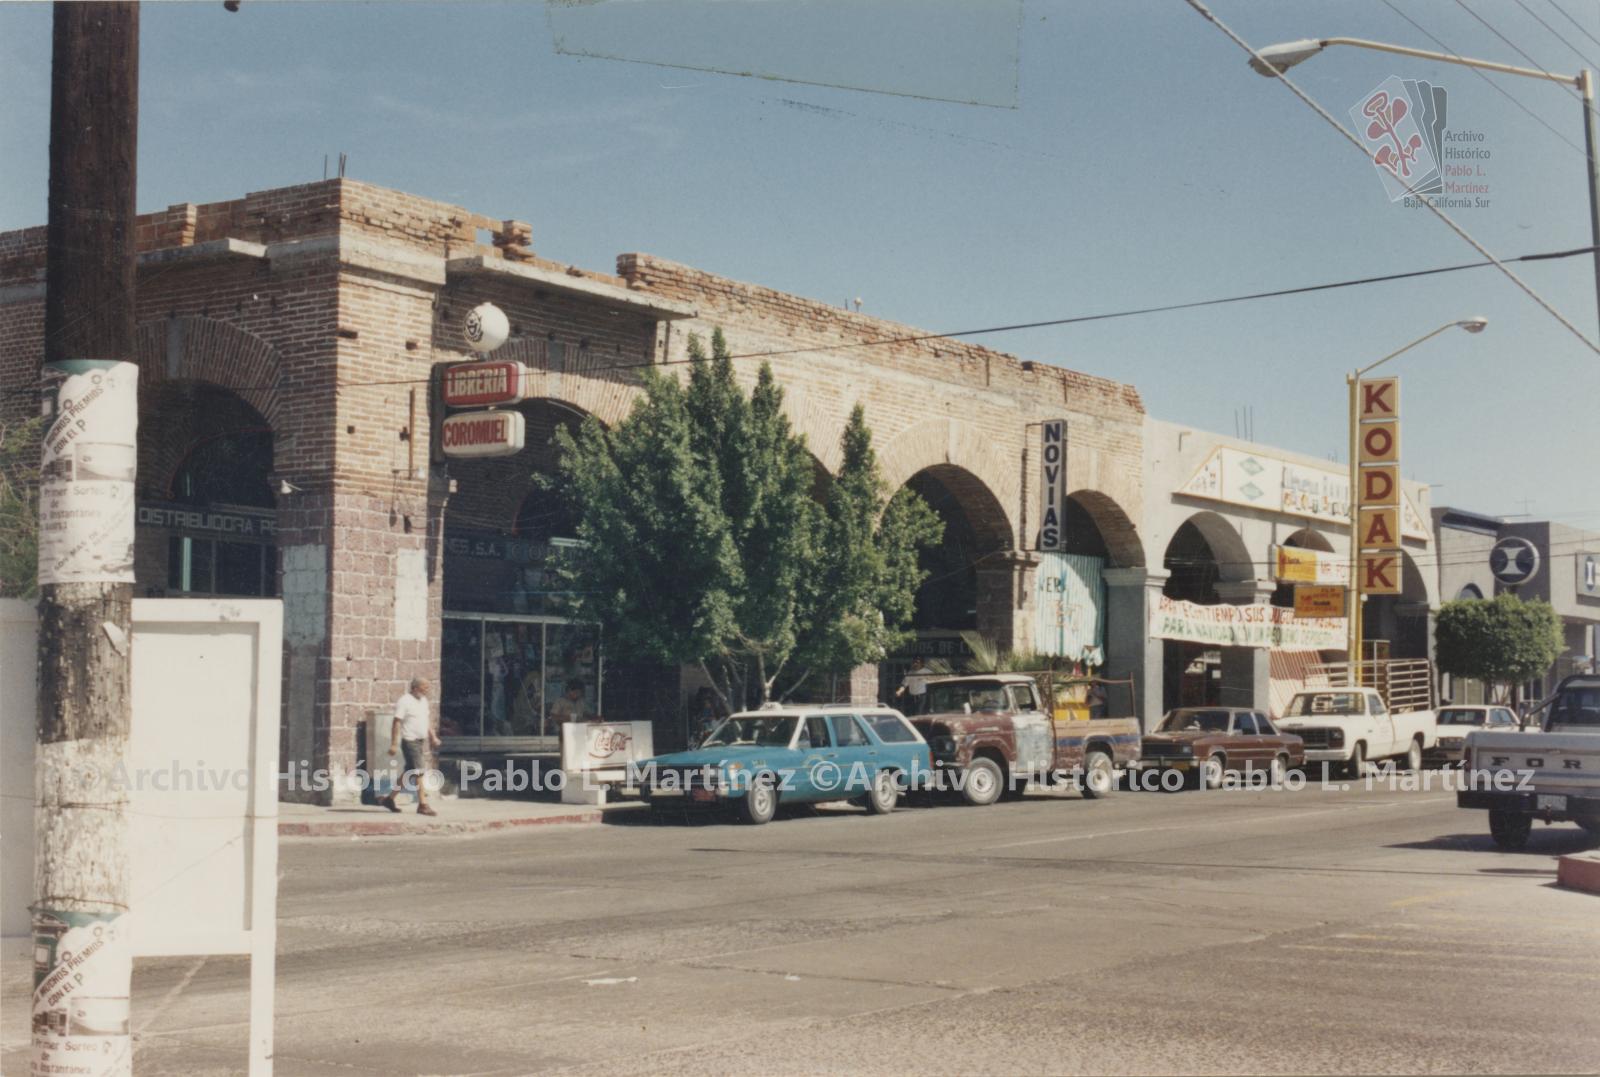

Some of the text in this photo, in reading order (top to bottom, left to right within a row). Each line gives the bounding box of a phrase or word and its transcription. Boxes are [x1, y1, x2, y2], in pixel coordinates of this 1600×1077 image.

[447, 367, 507, 397] LIBRERIA
[69, 385, 104, 418] PREMIOS
[53, 438, 68, 455] CON
[443, 419, 507, 447] COROMUEL
[1043, 422, 1061, 549] NOVIAS
[1362, 382, 1394, 590] KODAK
[138, 507, 252, 536] DISTRIBUIDORA
[1245, 607, 1265, 623] SUS
[67, 939, 104, 972] PREMIOS
[47, 988, 64, 1007] CON
